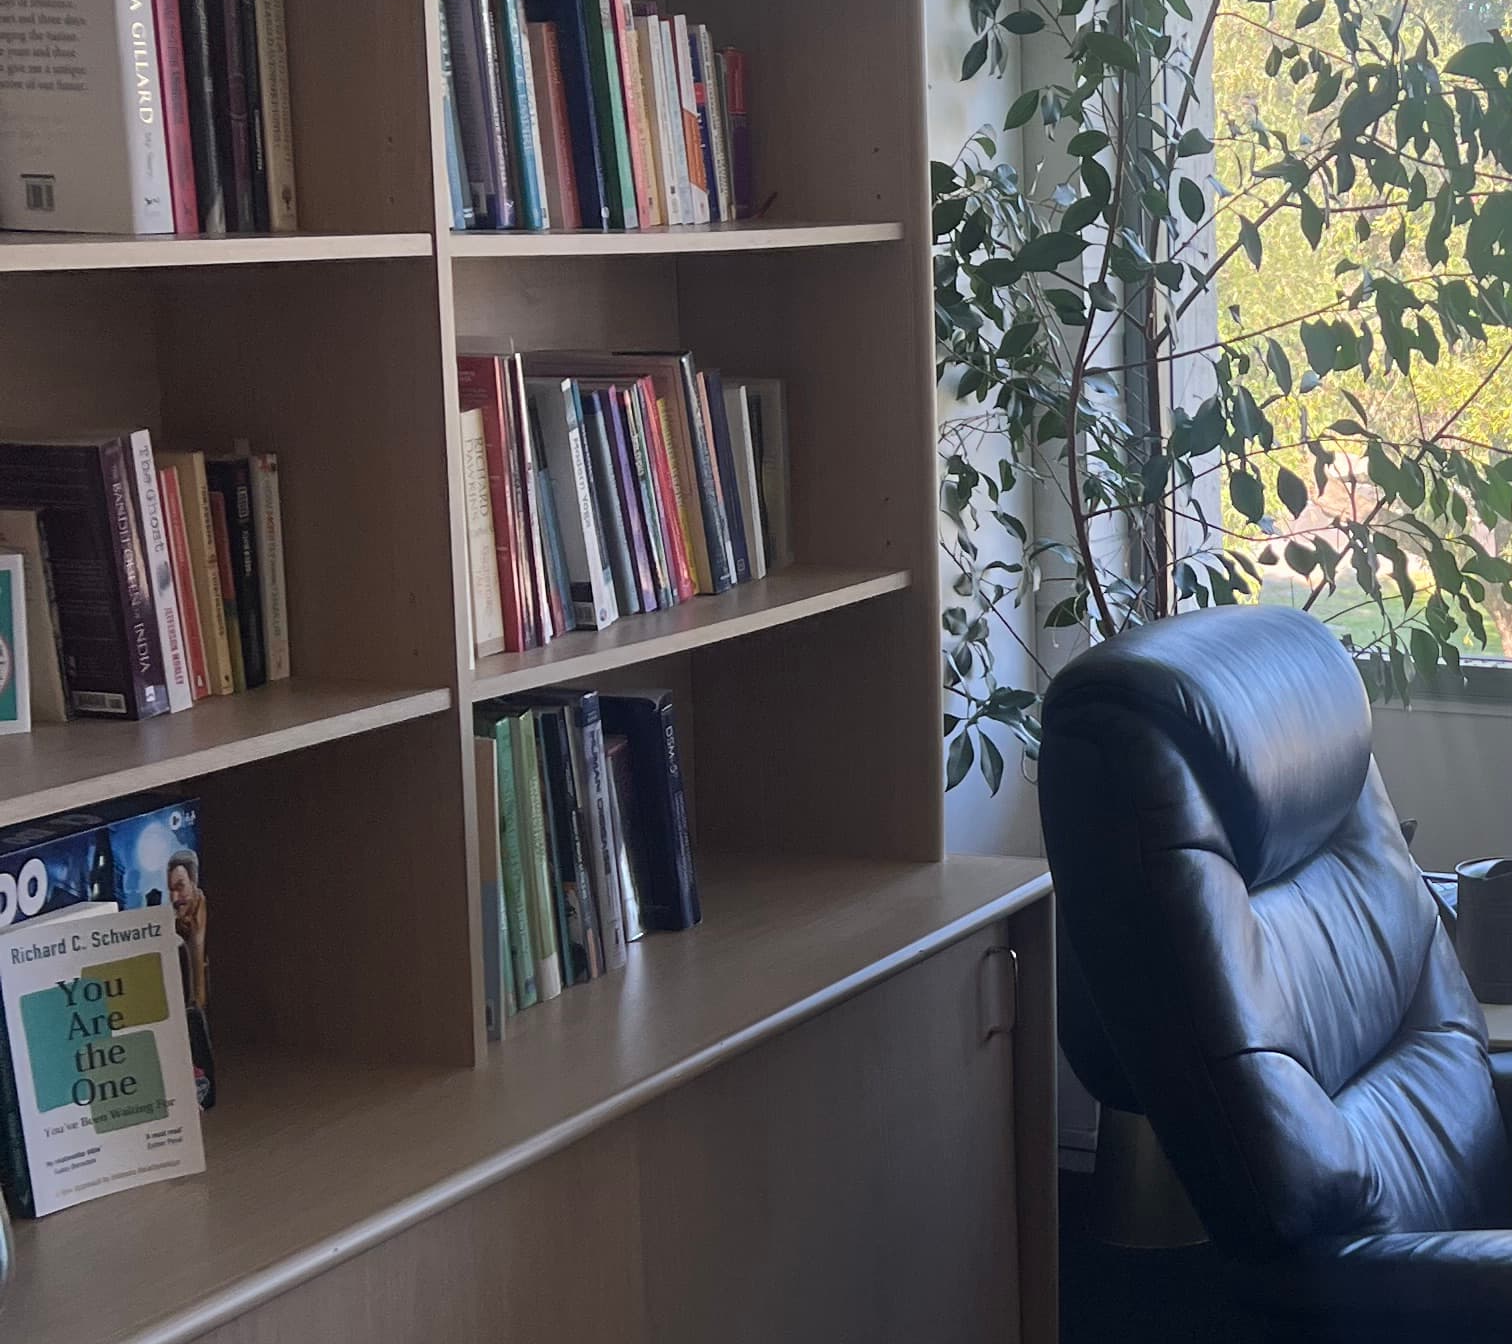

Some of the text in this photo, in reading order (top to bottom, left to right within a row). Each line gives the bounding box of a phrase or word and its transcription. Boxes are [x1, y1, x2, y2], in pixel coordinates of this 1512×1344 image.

[131, 21, 153, 125] GILLARD
[139, 444, 165, 553] The Ghost
[474, 437, 489, 517] RICHARD
[133, 622, 151, 673] INDIA
[10, 922, 162, 965] Richard C. Schwartz
[55, 976, 124, 1007] You
[68, 1010, 126, 1041] Are
[74, 1042, 126, 1073] the
[71, 1075, 137, 1107] One
